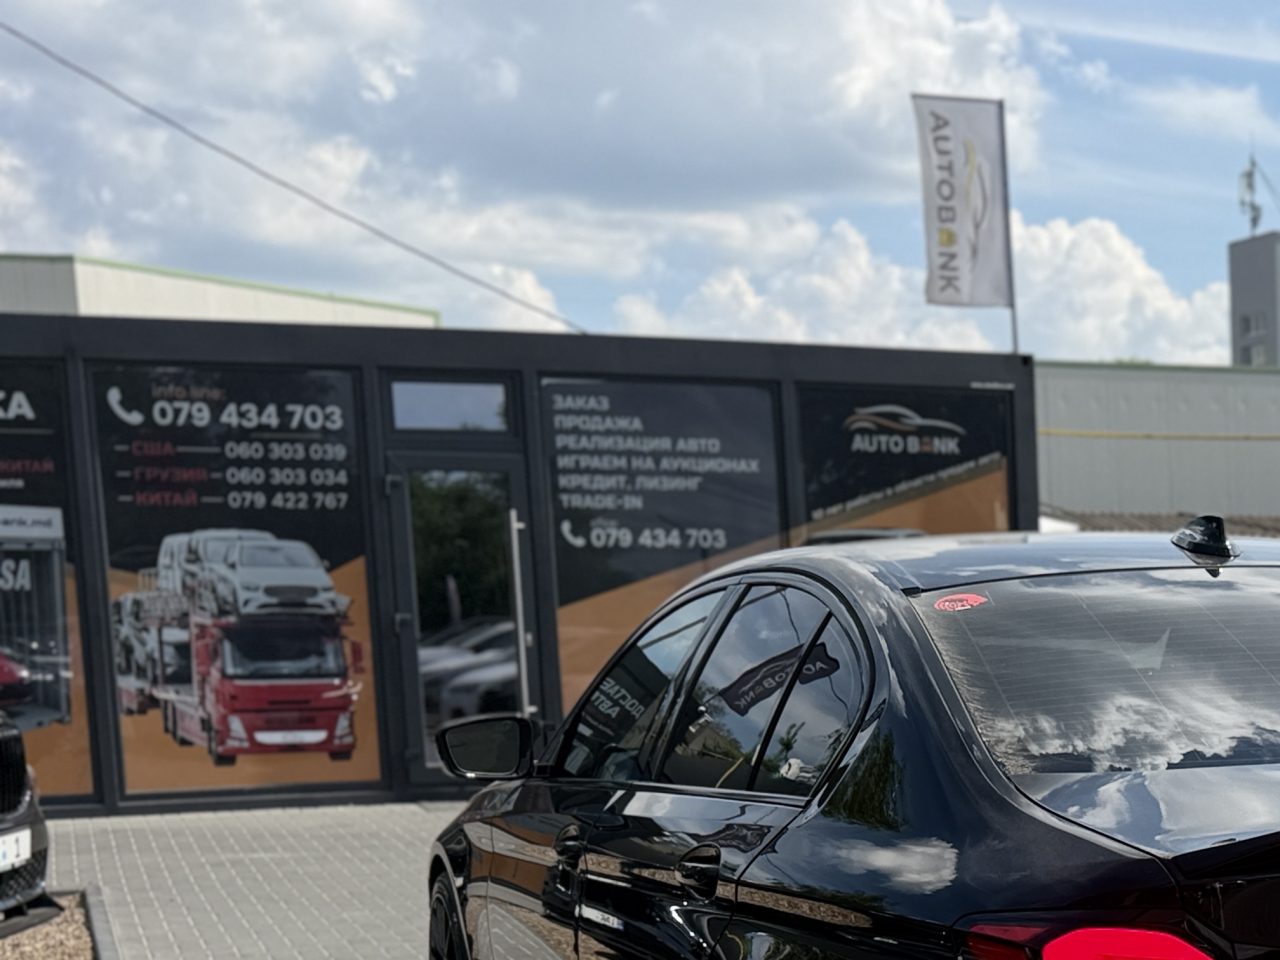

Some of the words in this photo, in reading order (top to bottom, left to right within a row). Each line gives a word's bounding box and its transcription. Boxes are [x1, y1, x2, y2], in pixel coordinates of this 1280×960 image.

[552, 394, 610, 412] ЗАКАЗ
[152, 400, 211, 428] 079
[219, 402, 280, 429] 434
[285, 403, 344, 431] 703
[554, 414, 643, 432] ПРОДАЖА
[131, 440, 176, 456] США
[224, 441, 264, 460] 060
[268, 442, 306, 461] 303
[309, 443, 347, 461] 039
[555, 434, 672, 453] РЕАЛИЗАЦИЯ
[675, 437, 721, 453] АВТО
[851, 433, 904, 454] AUTO
[556, 454, 629, 471] ИГРАЕМ
[631, 455, 655, 471] НА
[658, 456, 760, 474] АУКЦИОНАХ
[225, 466, 265, 485] 060
[269, 467, 307, 486] 303
[309, 468, 348, 486] 034
[635, 475, 703, 492] ЛИЗИНГ
[135, 489, 198, 507] КИТАЙ
[227, 490, 267, 510] 079
[271, 491, 309, 510] 422
[560, 493, 644, 511] TRADE-IN
[590, 527, 633, 549] 079
[638, 527, 681, 549] 434
[686, 528, 727, 549] 703
